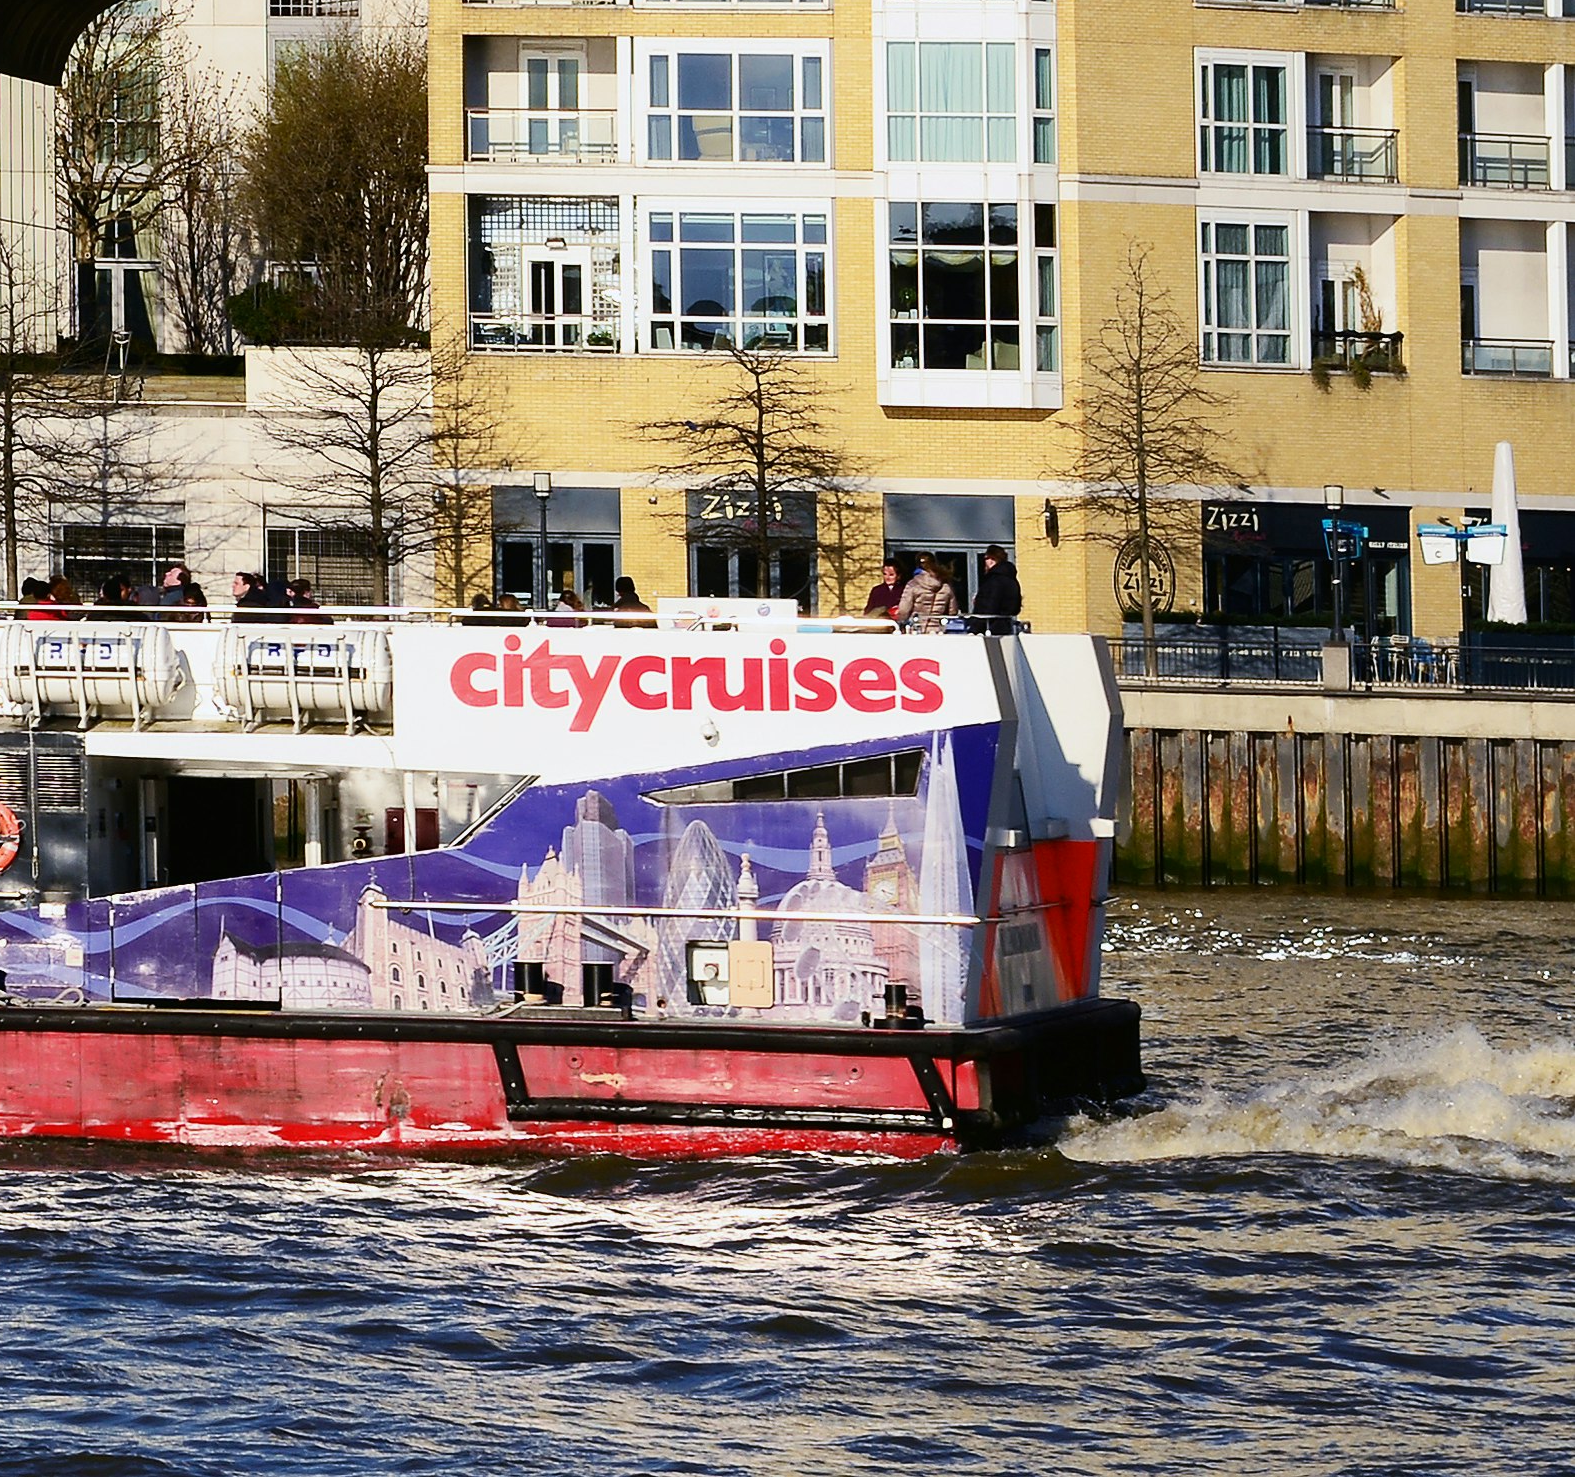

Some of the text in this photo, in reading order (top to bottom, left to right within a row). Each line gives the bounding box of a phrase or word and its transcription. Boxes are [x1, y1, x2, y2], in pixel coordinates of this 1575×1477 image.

[1206, 506, 1259, 532] Zizzi
[1123, 572, 1164, 592] Zizi
[50, 641, 112, 660] RD
[449, 633, 944, 732] citycruises
